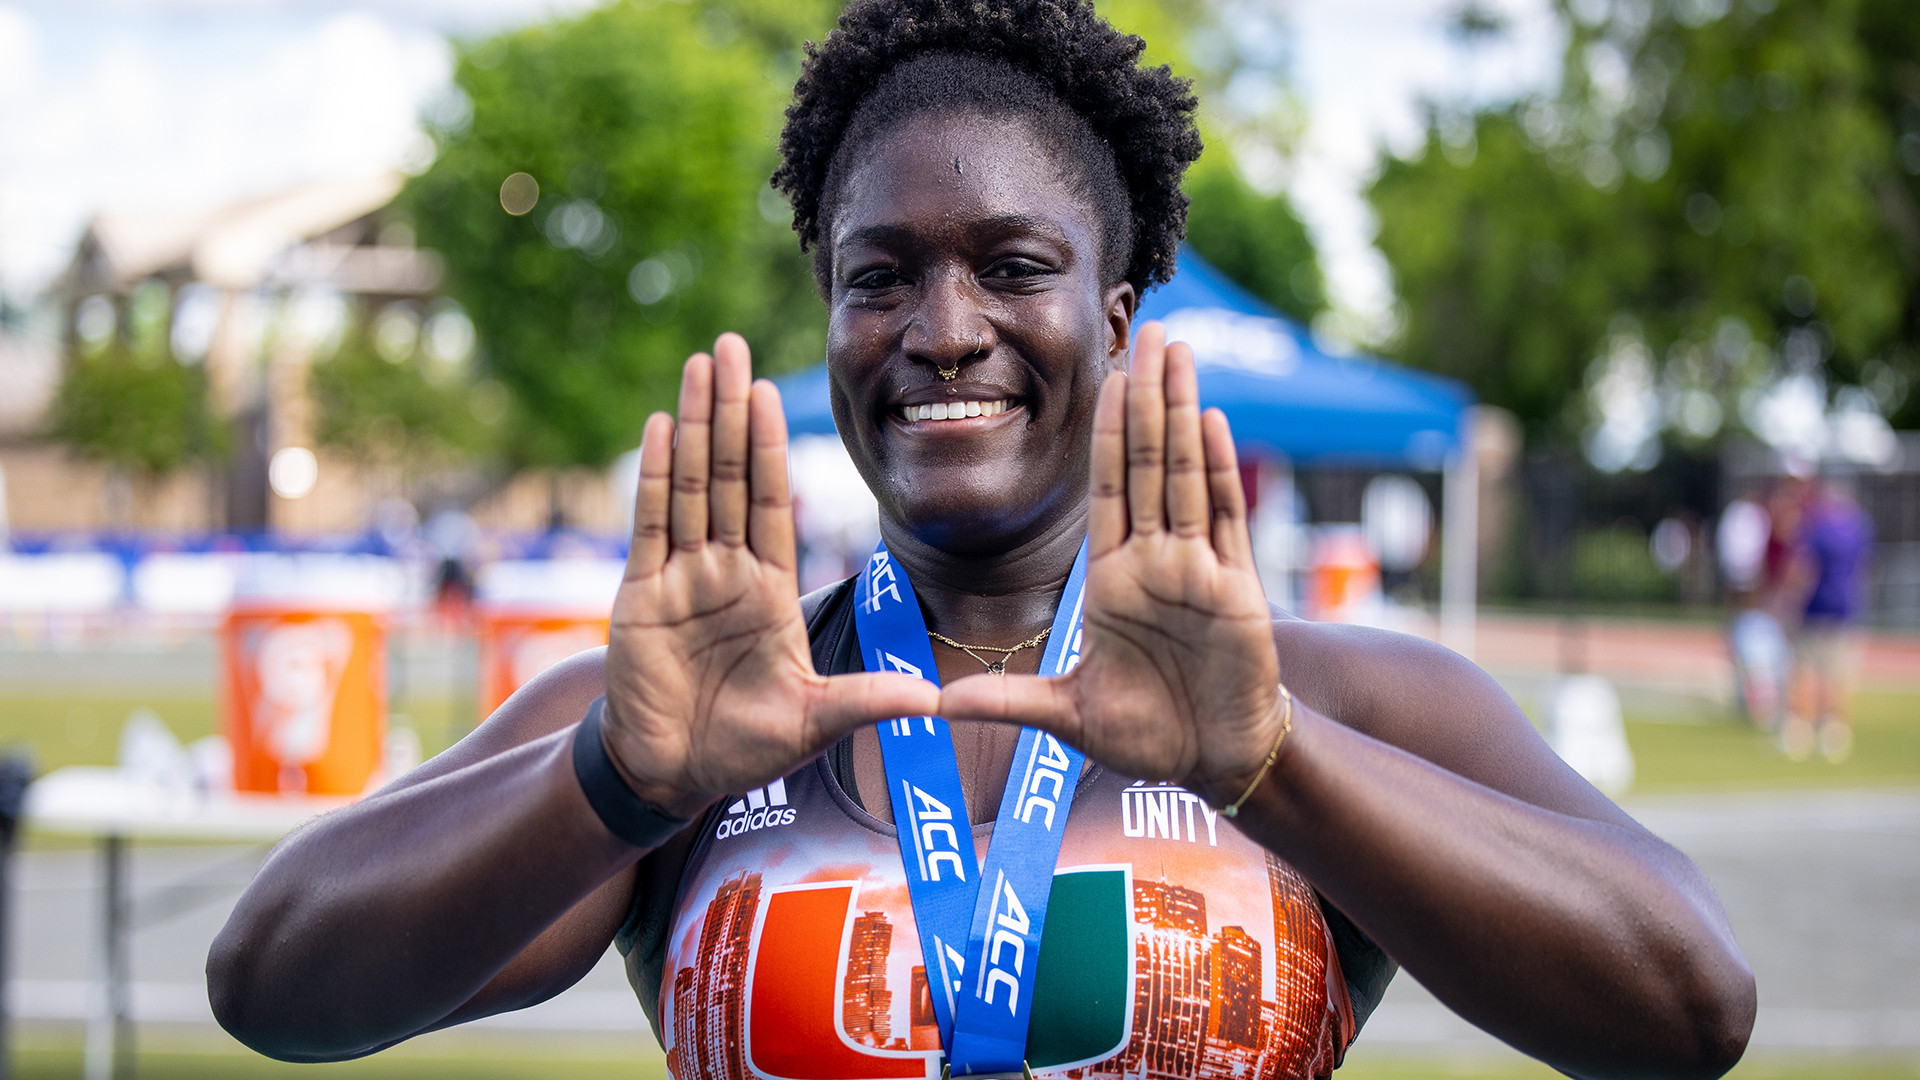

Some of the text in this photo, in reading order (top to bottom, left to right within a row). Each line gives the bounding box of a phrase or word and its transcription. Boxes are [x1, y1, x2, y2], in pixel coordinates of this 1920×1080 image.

[872, 551, 903, 612] ACC
[1021, 733, 1070, 831] ACC
[1121, 791, 1218, 847] UNITY
[716, 806, 797, 840] adidas
[912, 785, 966, 882] ACC
[984, 880, 1031, 1018] ACC
